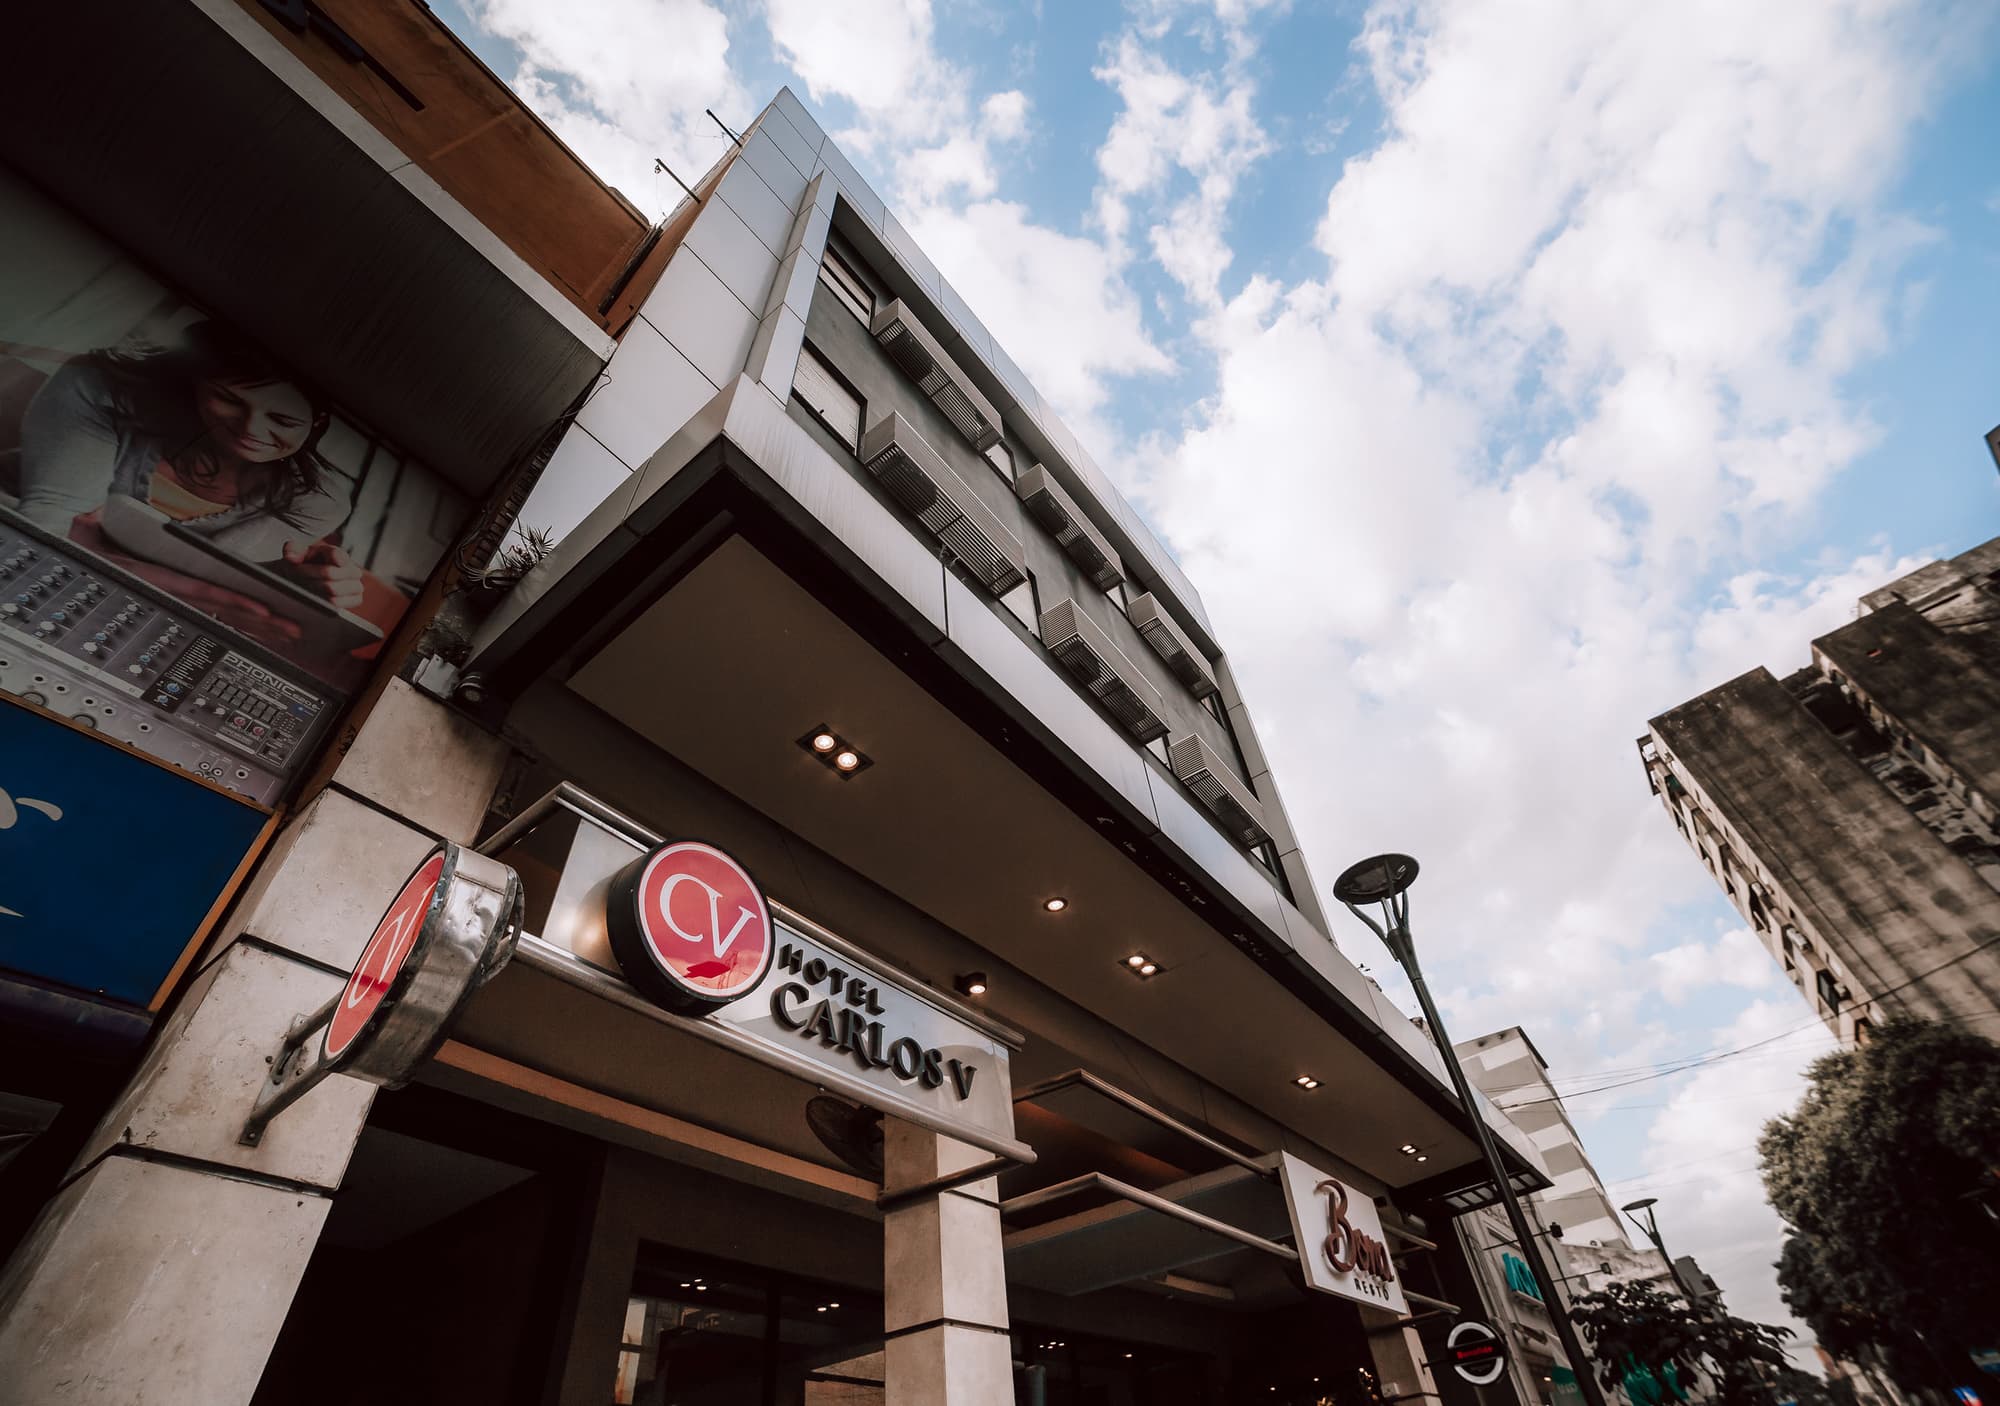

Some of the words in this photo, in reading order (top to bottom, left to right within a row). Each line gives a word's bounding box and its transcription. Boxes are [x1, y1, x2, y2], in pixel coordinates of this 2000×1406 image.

[223, 654, 295, 696] PHONIC
[777, 943, 885, 1016] HOTEL
[769, 982, 944, 1089] CARLOS
[949, 1058, 978, 1101] V
